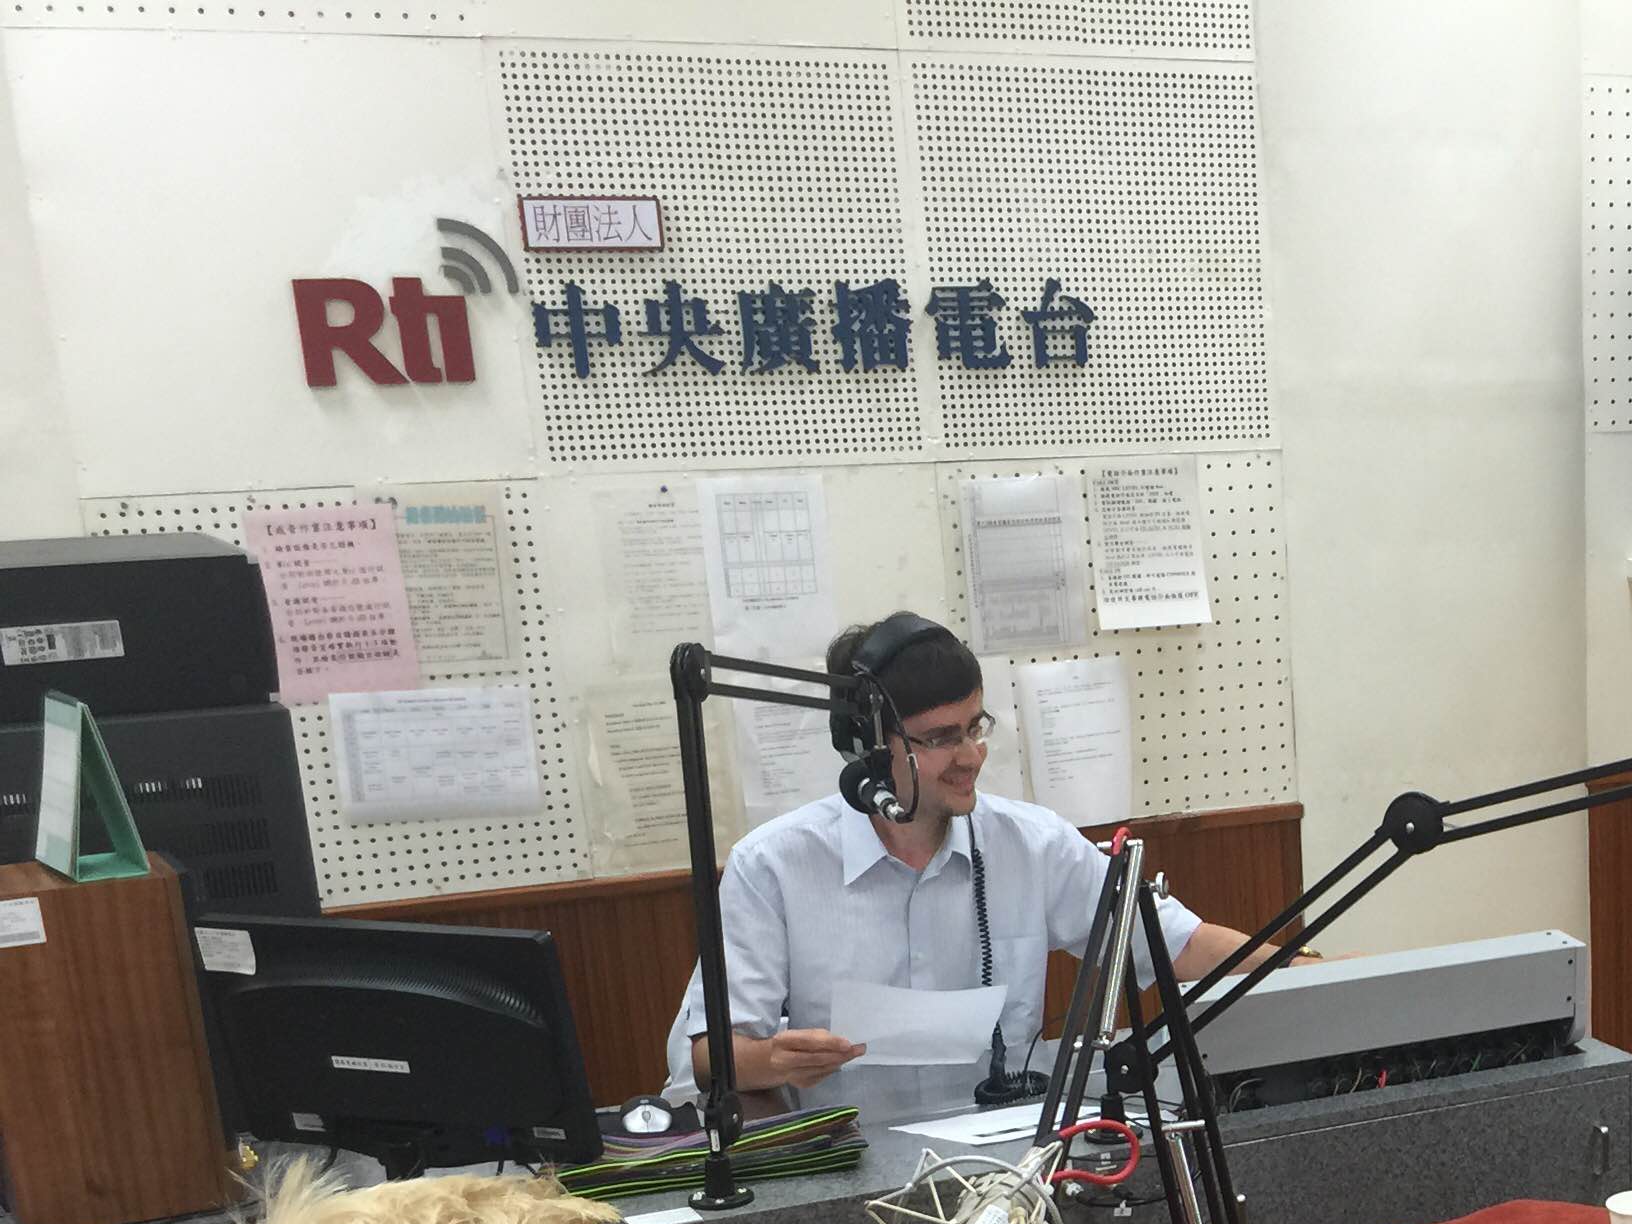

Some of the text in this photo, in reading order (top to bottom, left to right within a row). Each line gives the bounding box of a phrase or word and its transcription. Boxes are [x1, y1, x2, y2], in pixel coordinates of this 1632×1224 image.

[532, 204, 653, 243] 財團法人
[292, 277, 476, 387] Rti
[532, 279, 1096, 380] 中央廣播電台
